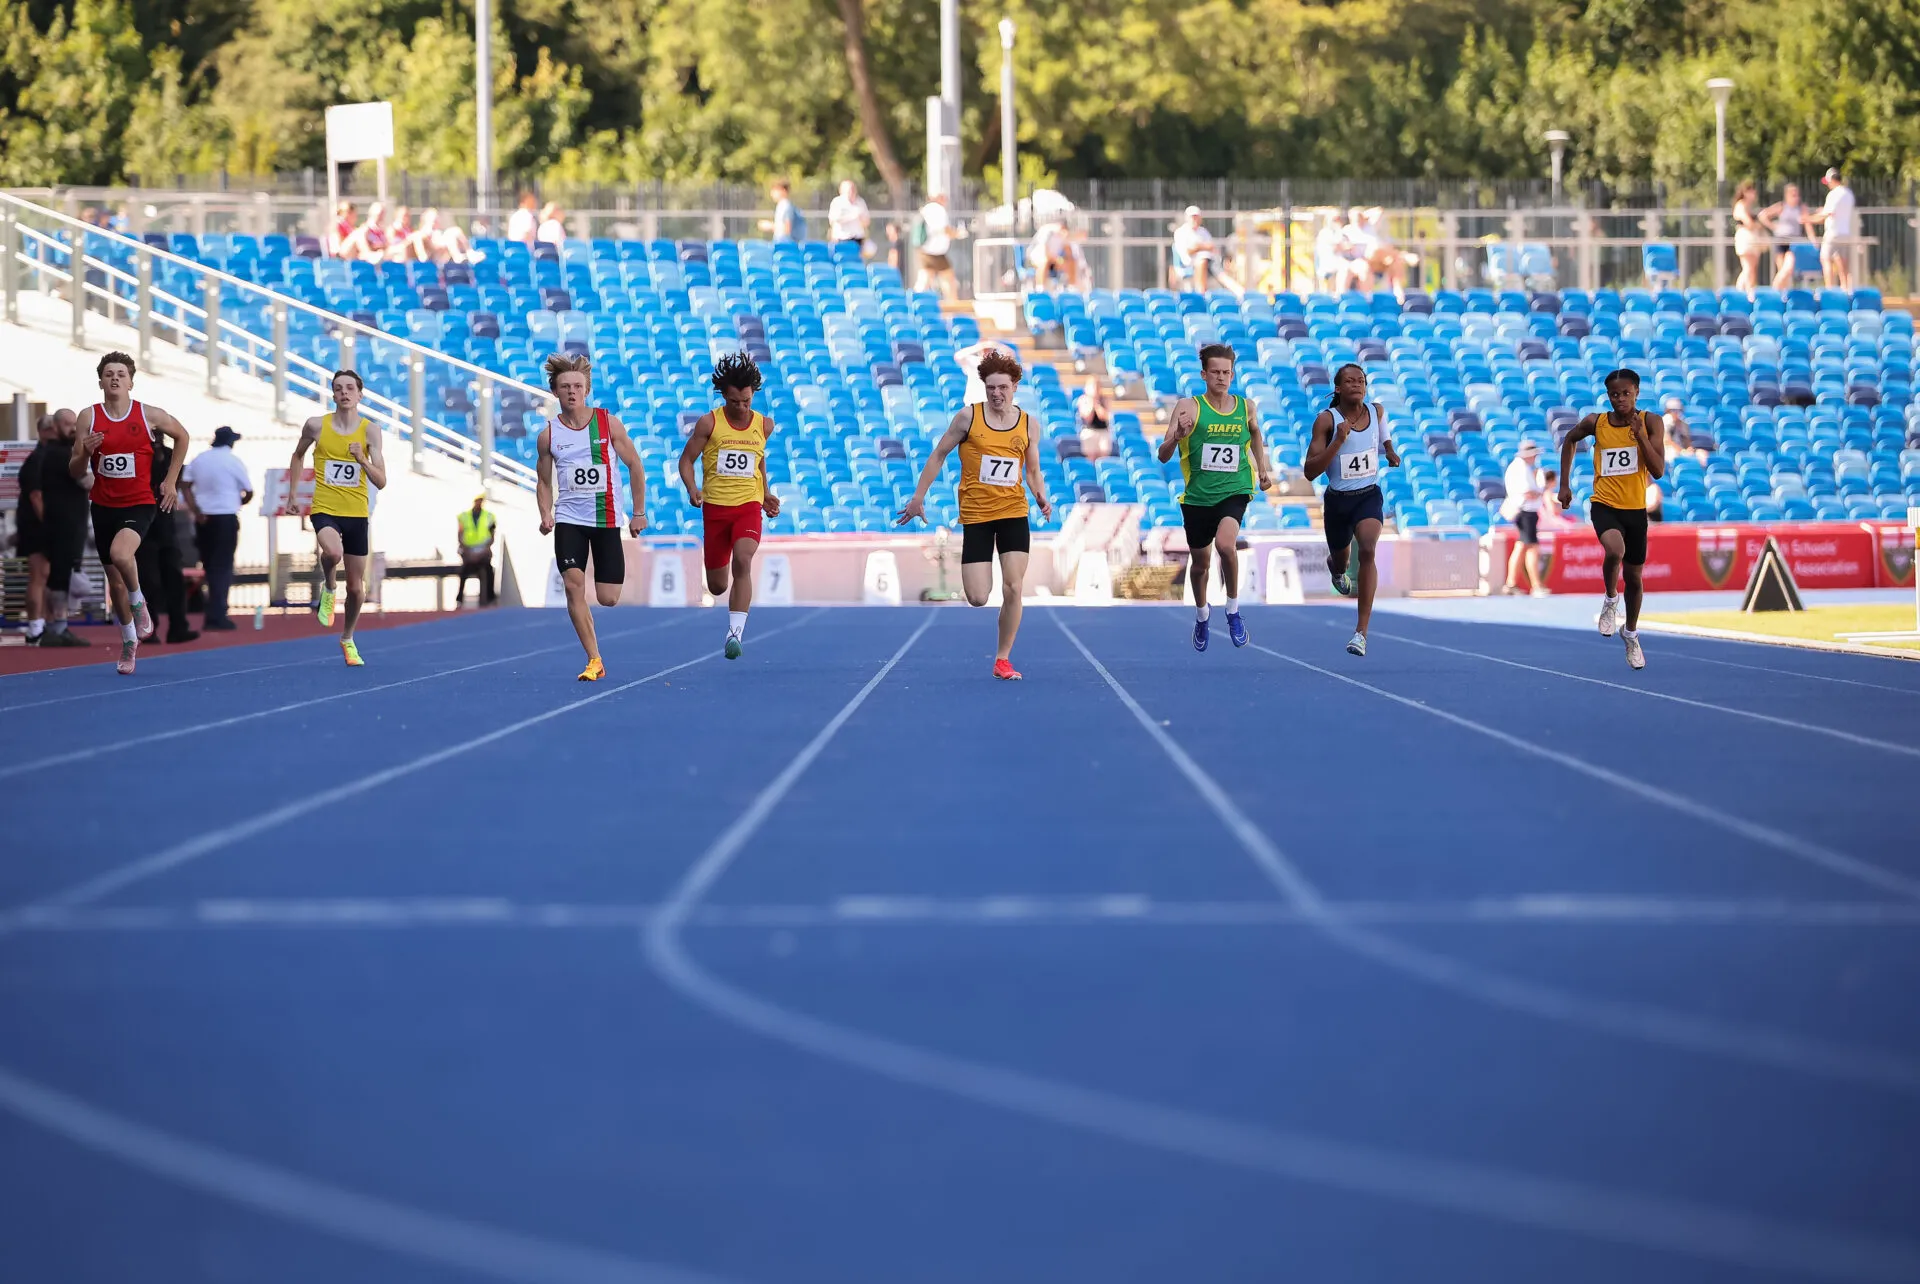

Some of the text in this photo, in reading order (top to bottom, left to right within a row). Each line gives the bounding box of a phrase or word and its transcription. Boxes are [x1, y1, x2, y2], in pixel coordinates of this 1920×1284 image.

[1207, 424, 1242, 433] STAFFS
[103, 456, 127, 471] 69
[725, 453, 748, 470] 59
[1211, 447, 1233, 464] 73
[1349, 454, 1369, 472] 41
[1607, 450, 1631, 468] 78
[333, 464, 354, 480] 79
[574, 468, 600, 485] 89
[990, 459, 1014, 478] 77
[661, 573, 675, 593] 8
[768, 573, 780, 593] 7
